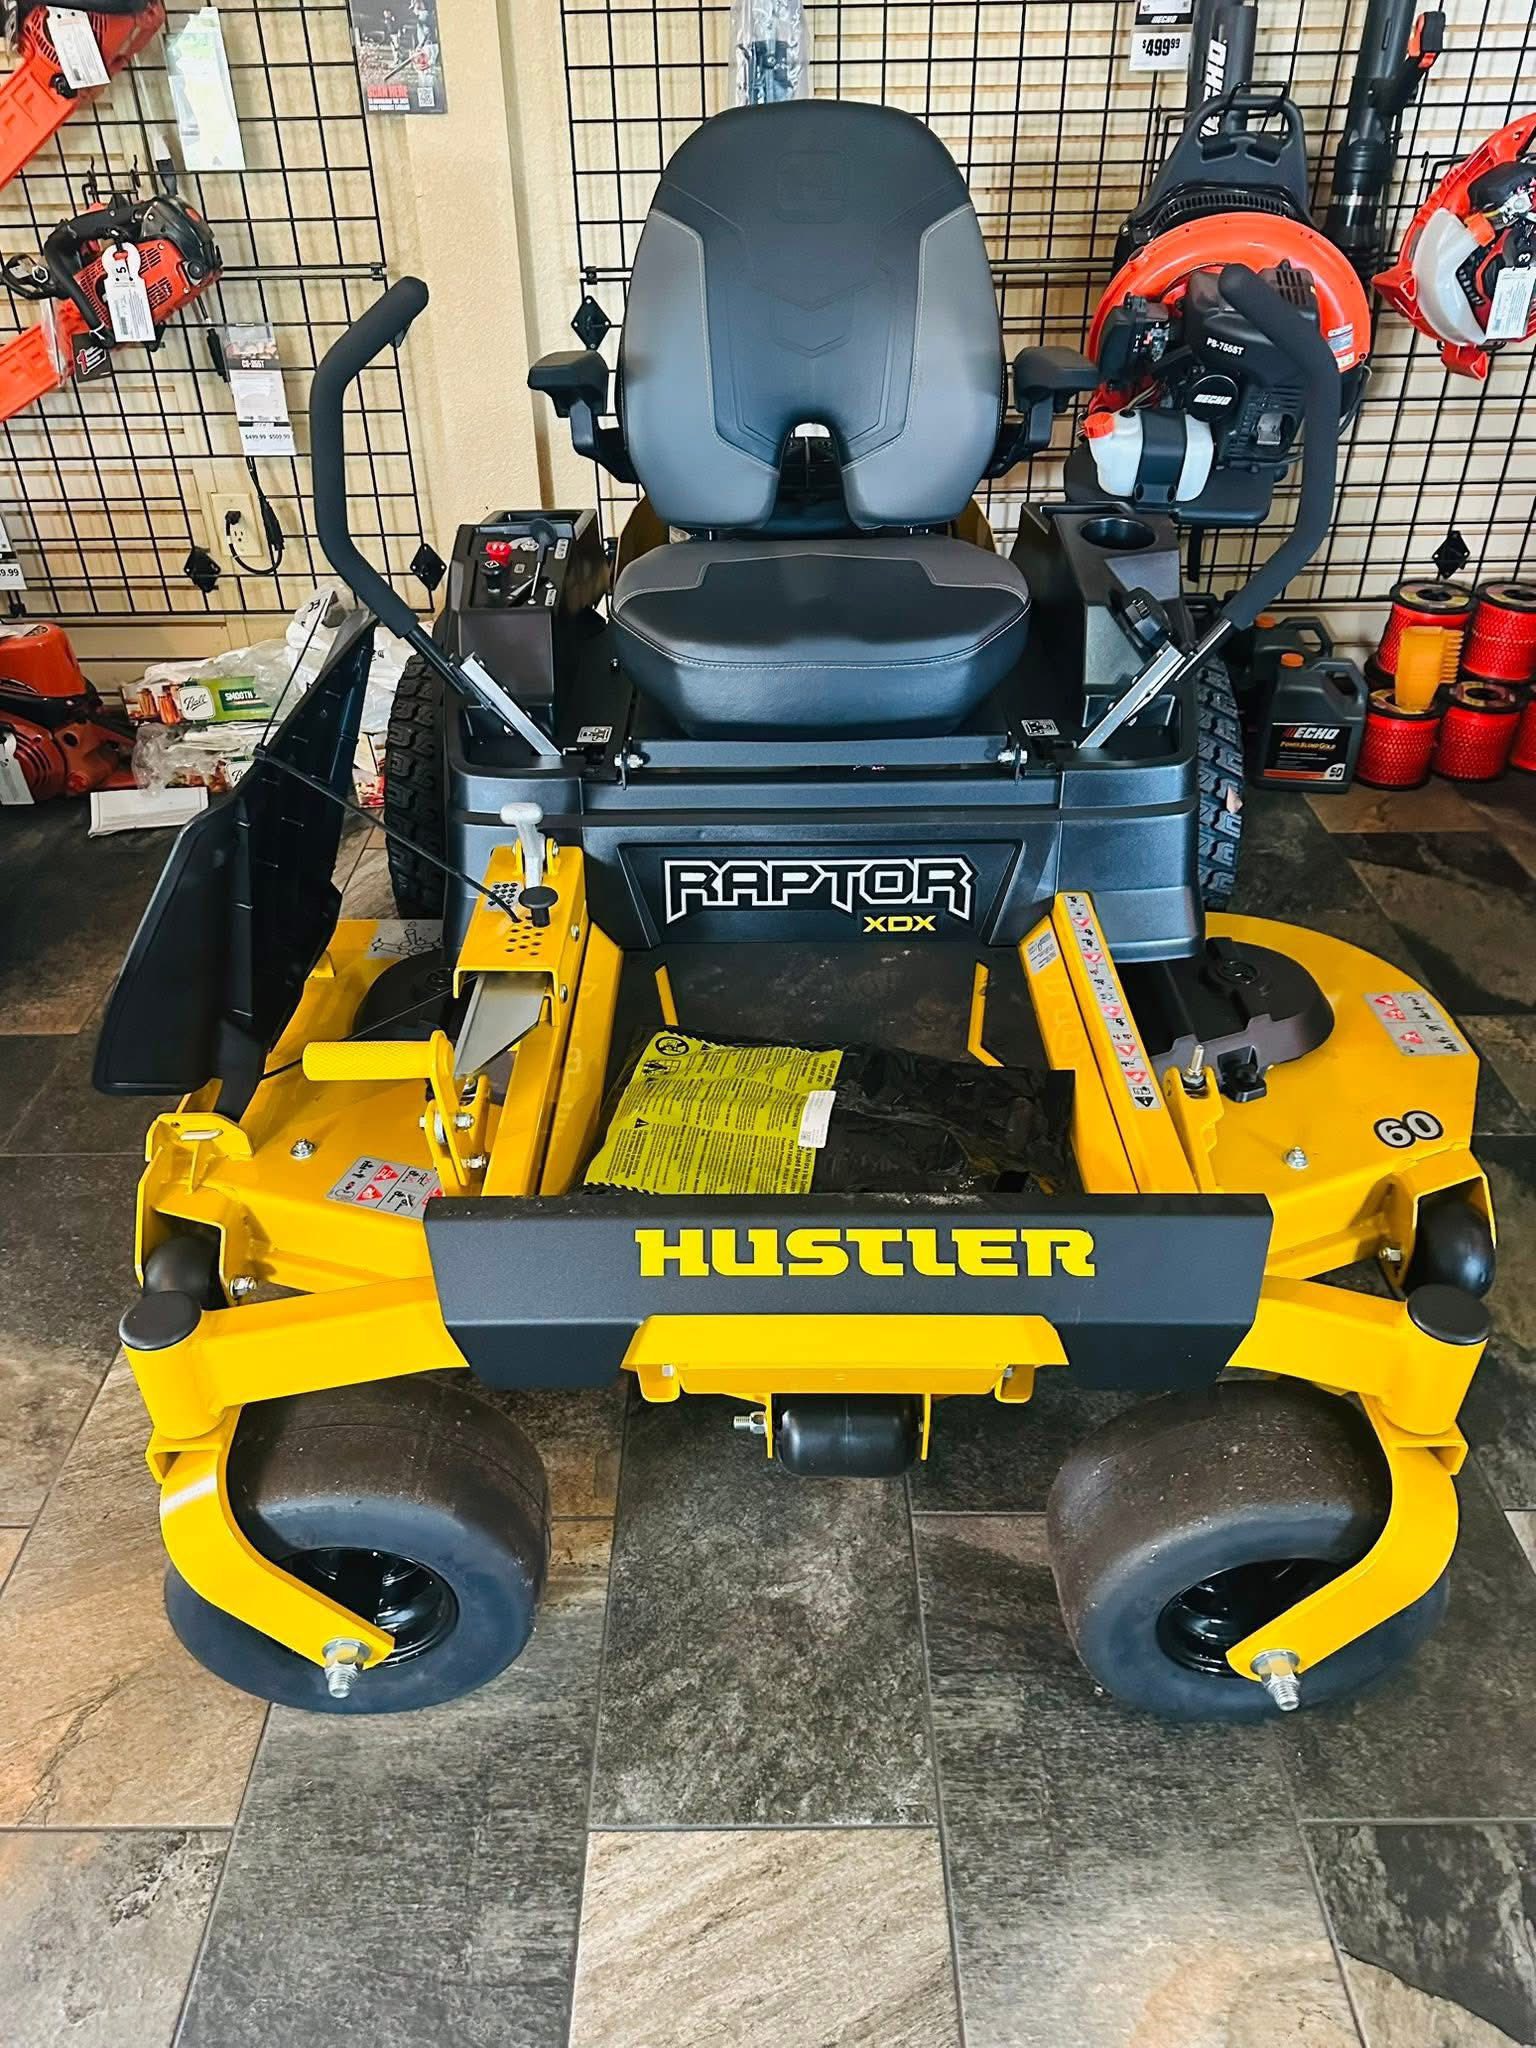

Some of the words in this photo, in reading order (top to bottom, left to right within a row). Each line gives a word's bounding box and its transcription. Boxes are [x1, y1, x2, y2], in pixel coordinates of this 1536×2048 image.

[1195, 393, 1233, 406] ECHO
[183, 693, 208, 712] Ball
[224, 690, 254, 701] SMOOTH
[1295, 727, 1340, 740] ECHO
[663, 857, 975, 924] RAPTOR
[862, 915, 937, 933] XDX
[1374, 1110, 1444, 1148] 60
[634, 1228, 1096, 1277] HUSTLER
